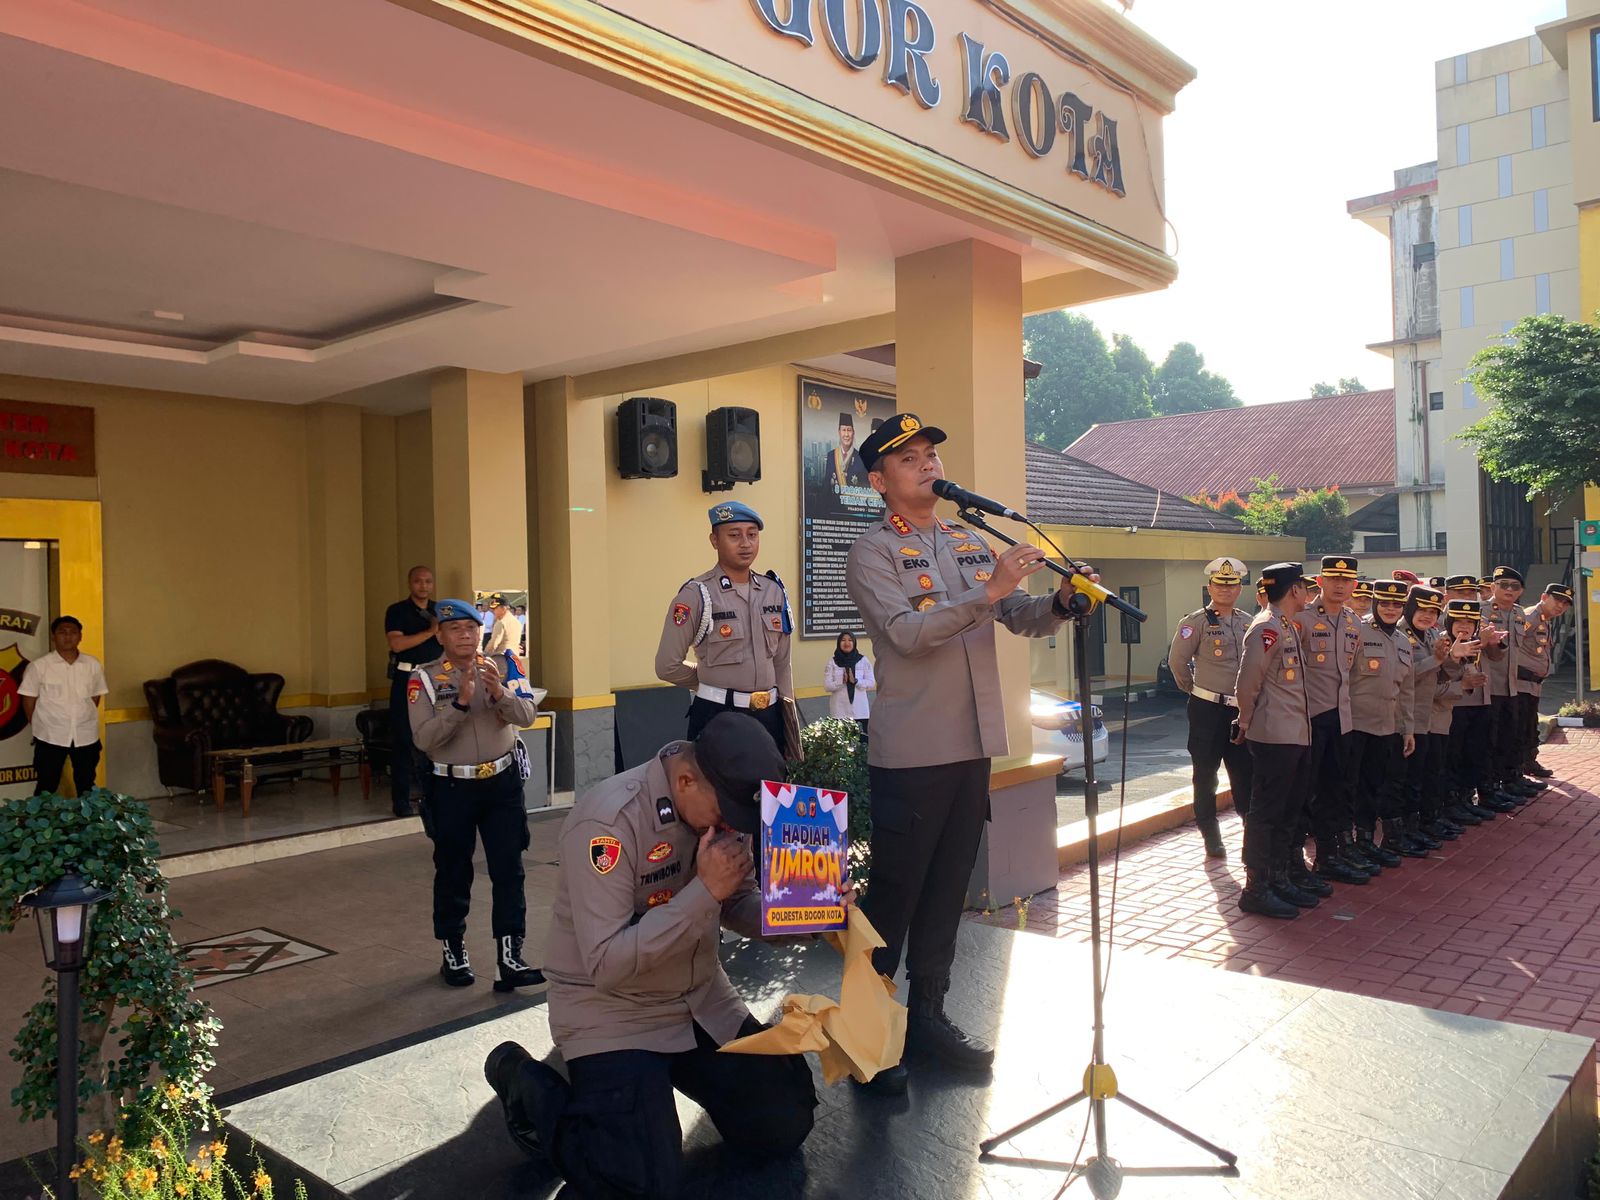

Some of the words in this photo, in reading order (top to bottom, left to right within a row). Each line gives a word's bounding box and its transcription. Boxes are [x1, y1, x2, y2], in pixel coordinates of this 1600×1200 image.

[959, 31, 1126, 198] KOTA
[902, 559, 930, 570] EKO
[957, 554, 992, 566] POLRI
[781, 823, 830, 846] HADIAH
[769, 848, 843, 893] UMROH
[771, 910, 803, 922] POLRESTA
[804, 909, 826, 921] BOGOR
[826, 907, 843, 919] KOTA
